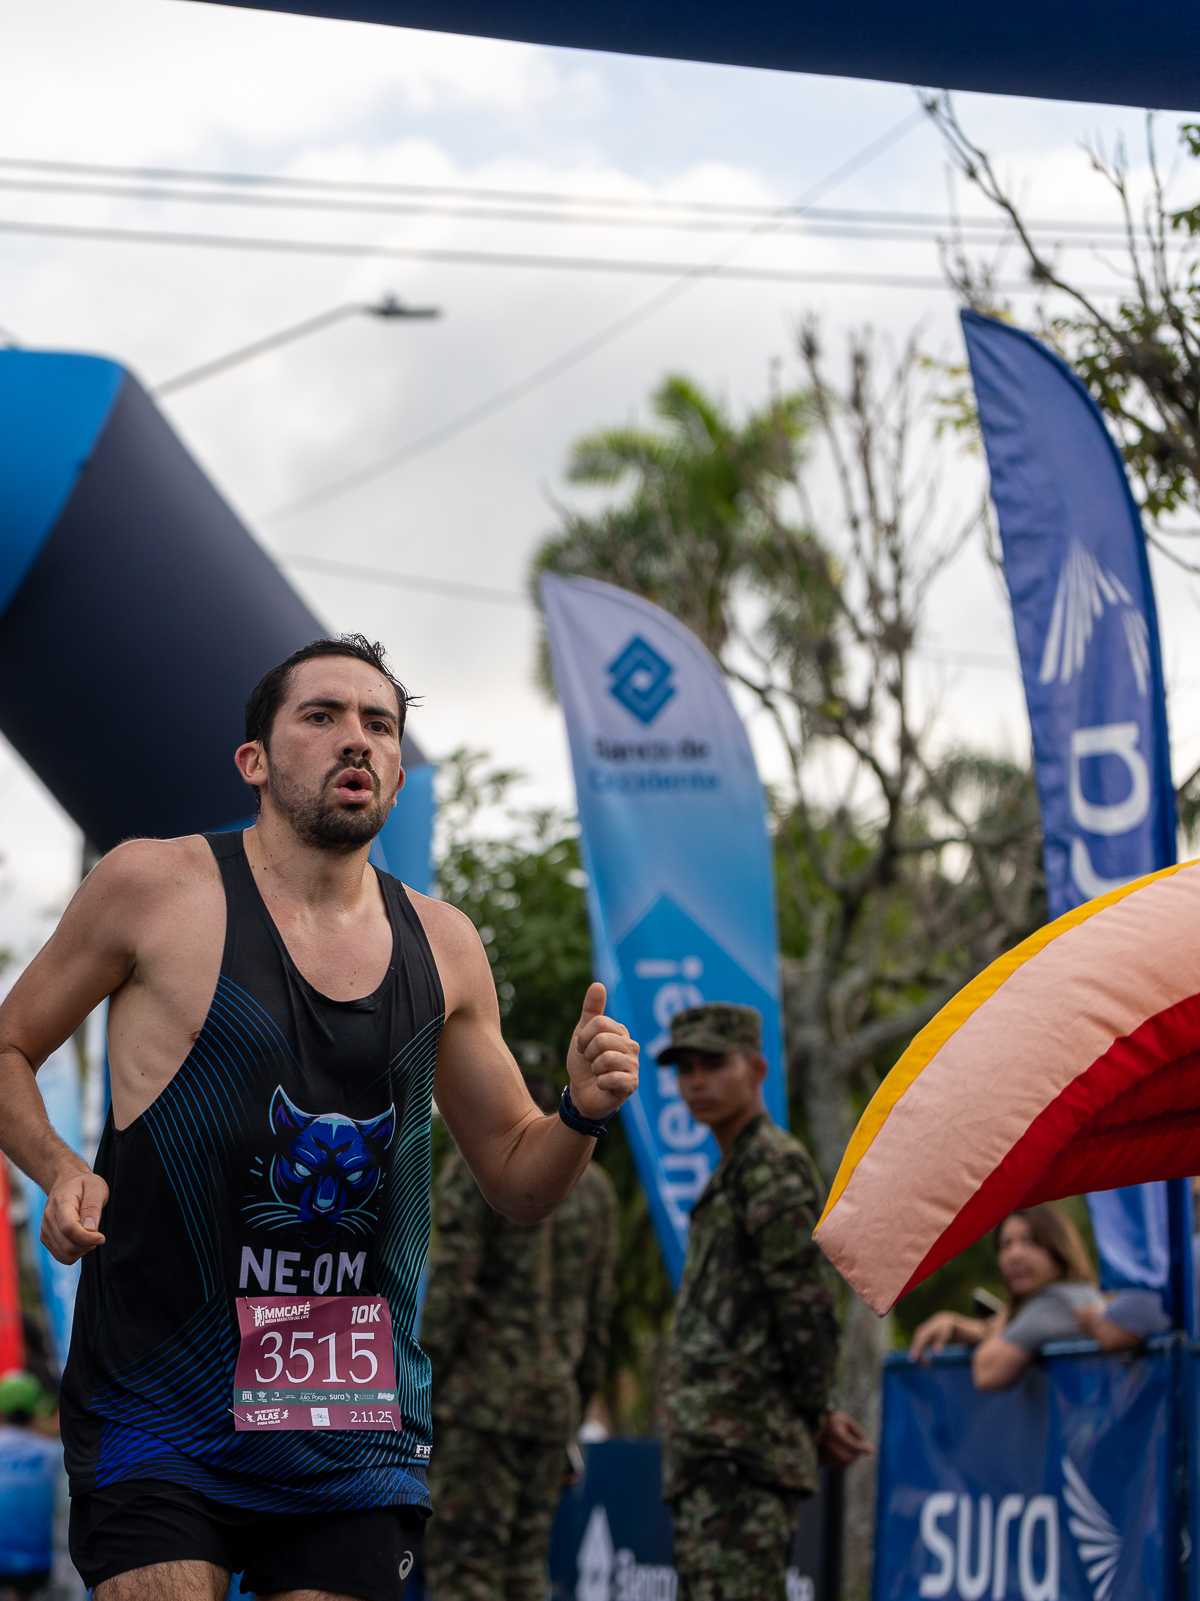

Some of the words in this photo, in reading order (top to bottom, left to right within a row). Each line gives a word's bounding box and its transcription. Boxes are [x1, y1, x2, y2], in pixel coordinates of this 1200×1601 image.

[238, 1245, 367, 1295] NE-OM
[264, 1301, 311, 1320] MMCAFÉ
[351, 1303, 382, 1325] 10K
[255, 1331, 379, 1384] 3515
[256, 1412, 279, 1421] ALAS
[350, 1410, 393, 1423] 2.11.25
[918, 1491, 1060, 1601] sura
